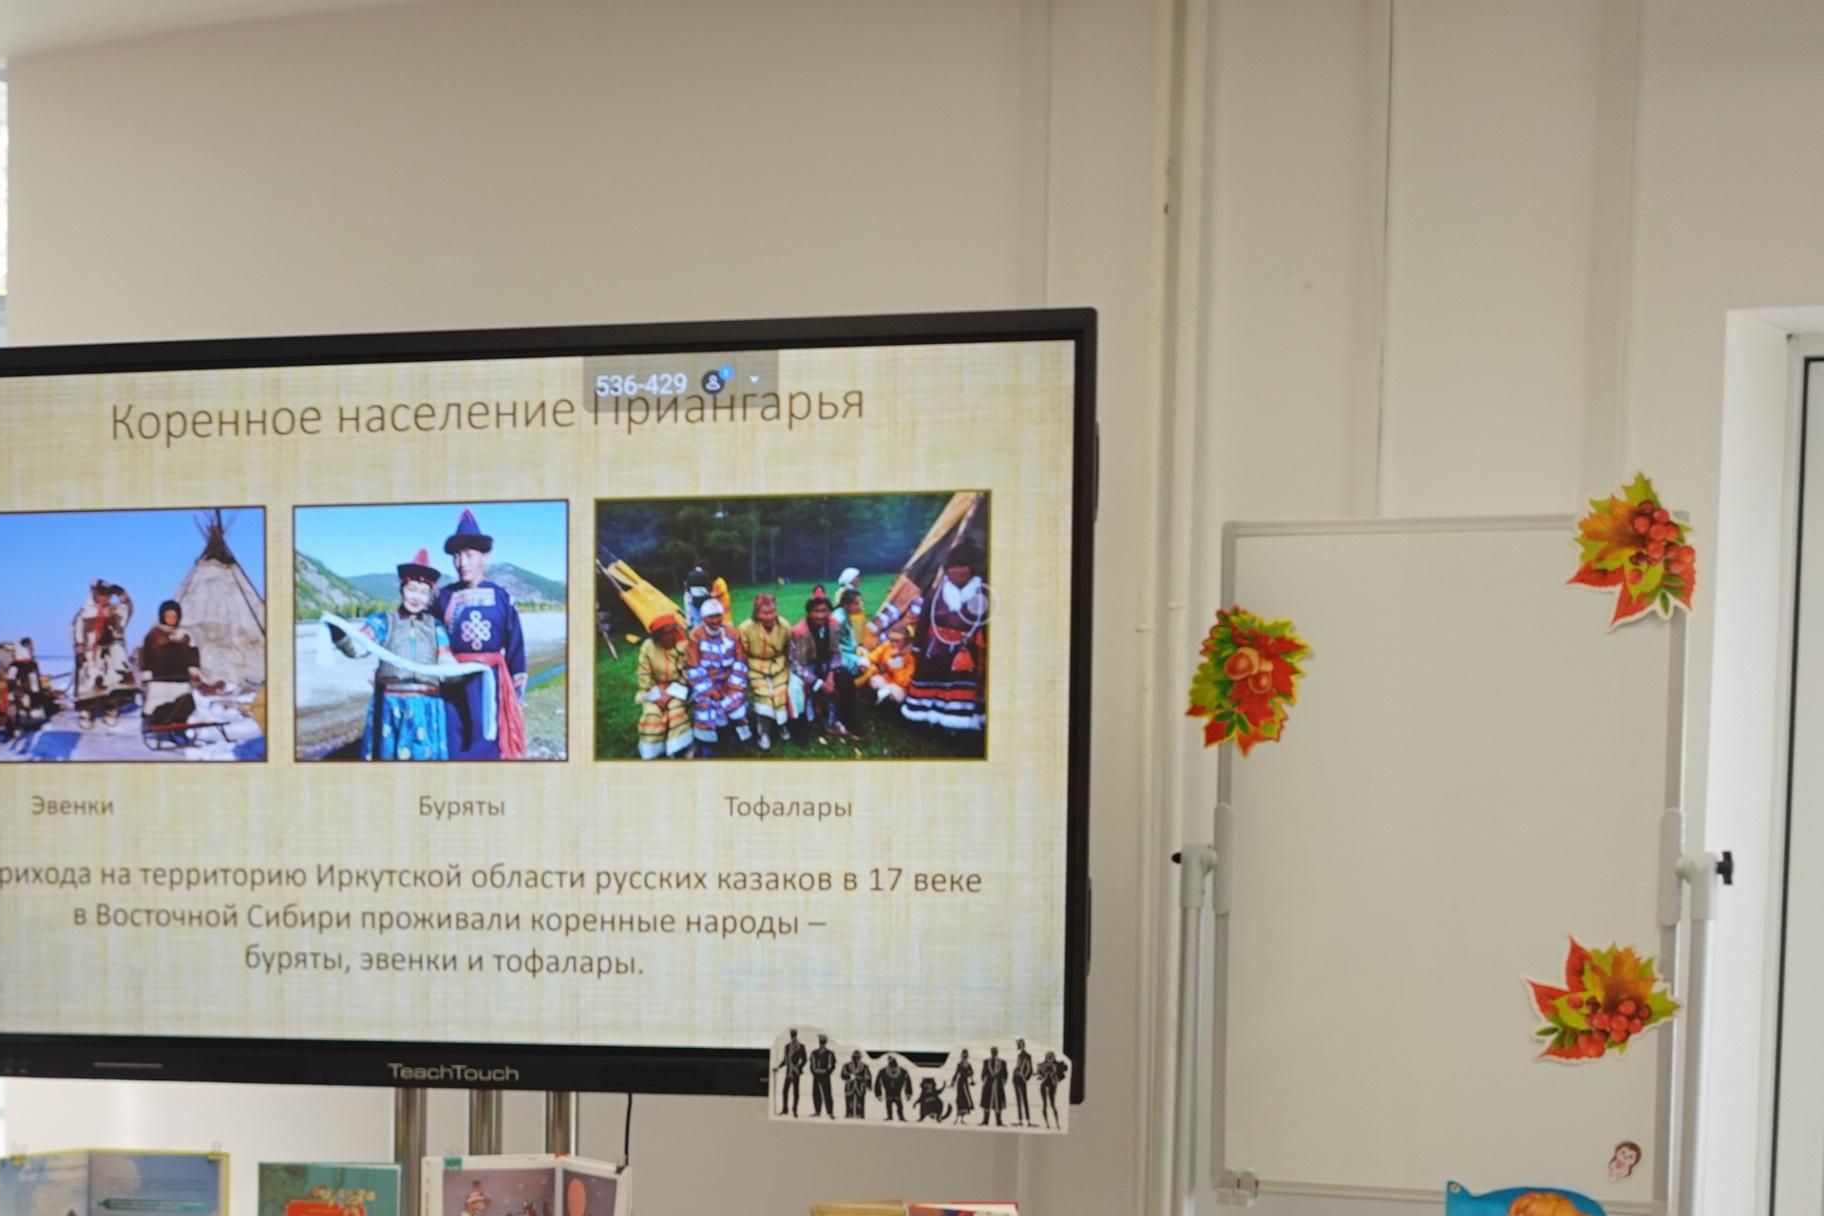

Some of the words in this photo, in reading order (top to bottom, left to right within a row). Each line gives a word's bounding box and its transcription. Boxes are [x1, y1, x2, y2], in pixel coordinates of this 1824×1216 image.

[595, 373, 688, 398] 536-429
[112, 403, 323, 447] Коренное
[338, 396, 576, 434] население
[592, 388, 865, 434] Приангарья
[31, 795, 114, 816] Эвенки
[417, 796, 505, 821] Буряты
[724, 795, 854, 821] Тофалары
[100, 866, 132, 885] на
[140, 866, 307, 891] территорию
[316, 863, 462, 892] Иркутской
[471, 864, 584, 891] области
[595, 869, 708, 898] русских
[716, 870, 833, 892] казаков
[843, 870, 858, 892] в
[868, 867, 903, 892] 17
[913, 871, 983, 894] веке
[73, 908, 87, 927] в
[96, 903, 239, 930] Восточной
[247, 905, 352, 932] Сибири
[360, 909, 521, 932] проживали
[531, 911, 677, 934] коренные
[685, 913, 799, 938] народы
[245, 945, 351, 973] буряты,
[360, 950, 458, 972] эвенки
[467, 951, 484, 972] и
[494, 951, 644, 978] тофалары.
[386, 1062, 520, 1081] TeachTouch
